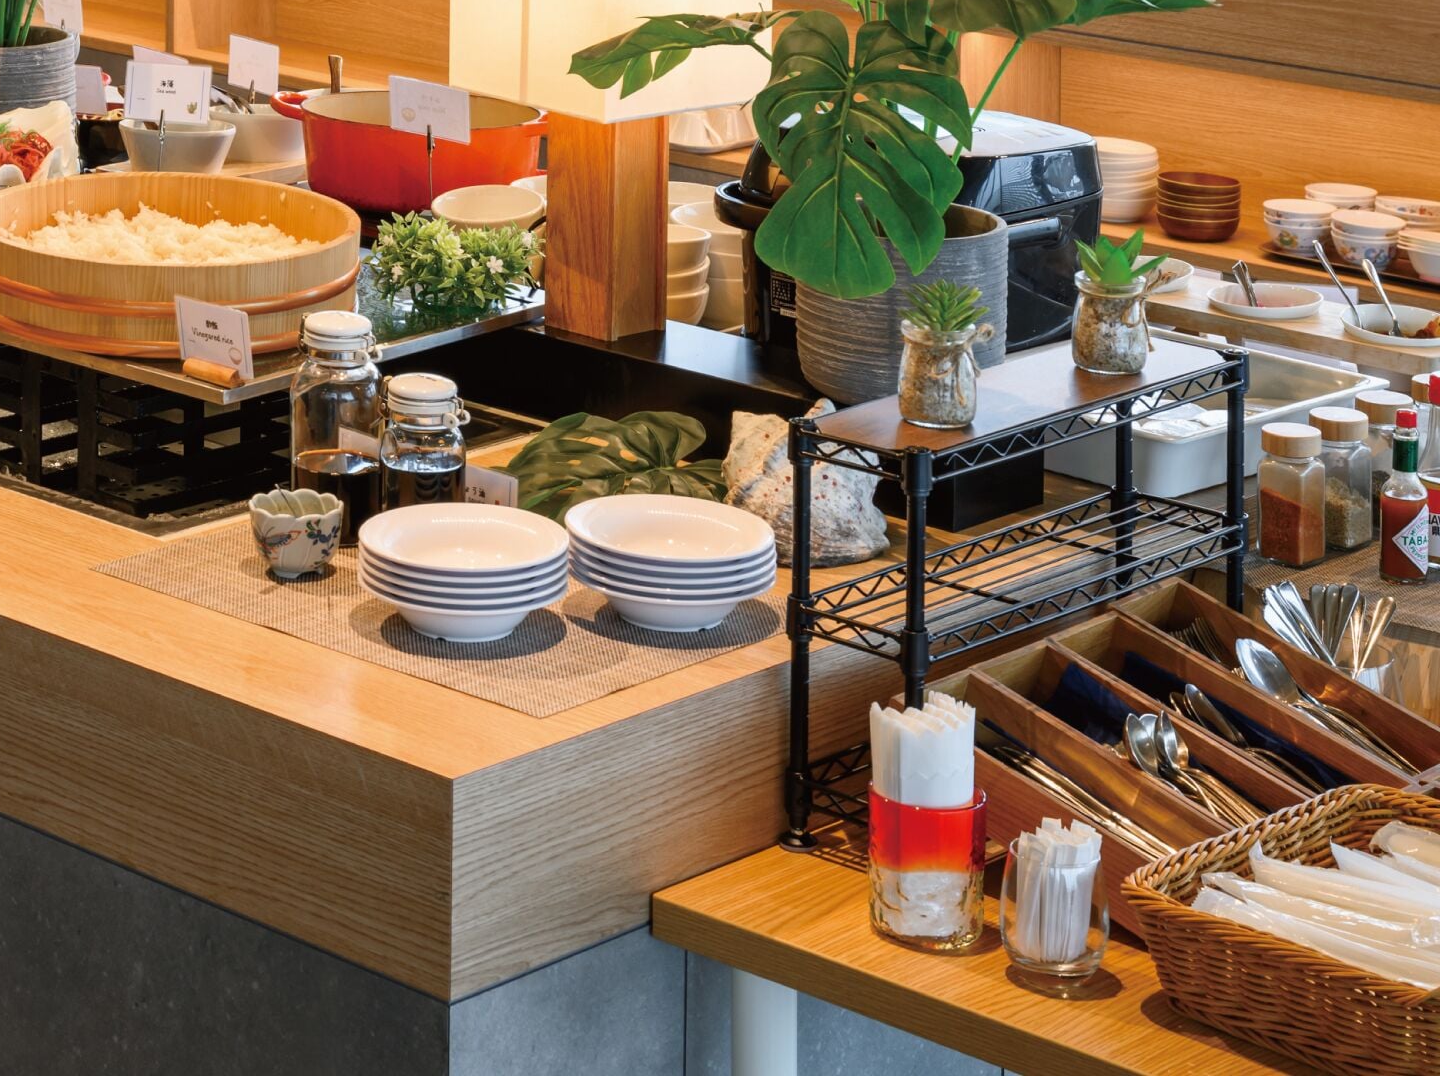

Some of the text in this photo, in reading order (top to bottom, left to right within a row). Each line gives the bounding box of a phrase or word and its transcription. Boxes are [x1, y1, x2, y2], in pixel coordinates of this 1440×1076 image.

[191, 326, 234, 345] Vinegared rice
[1402, 535, 1428, 546] TABA
